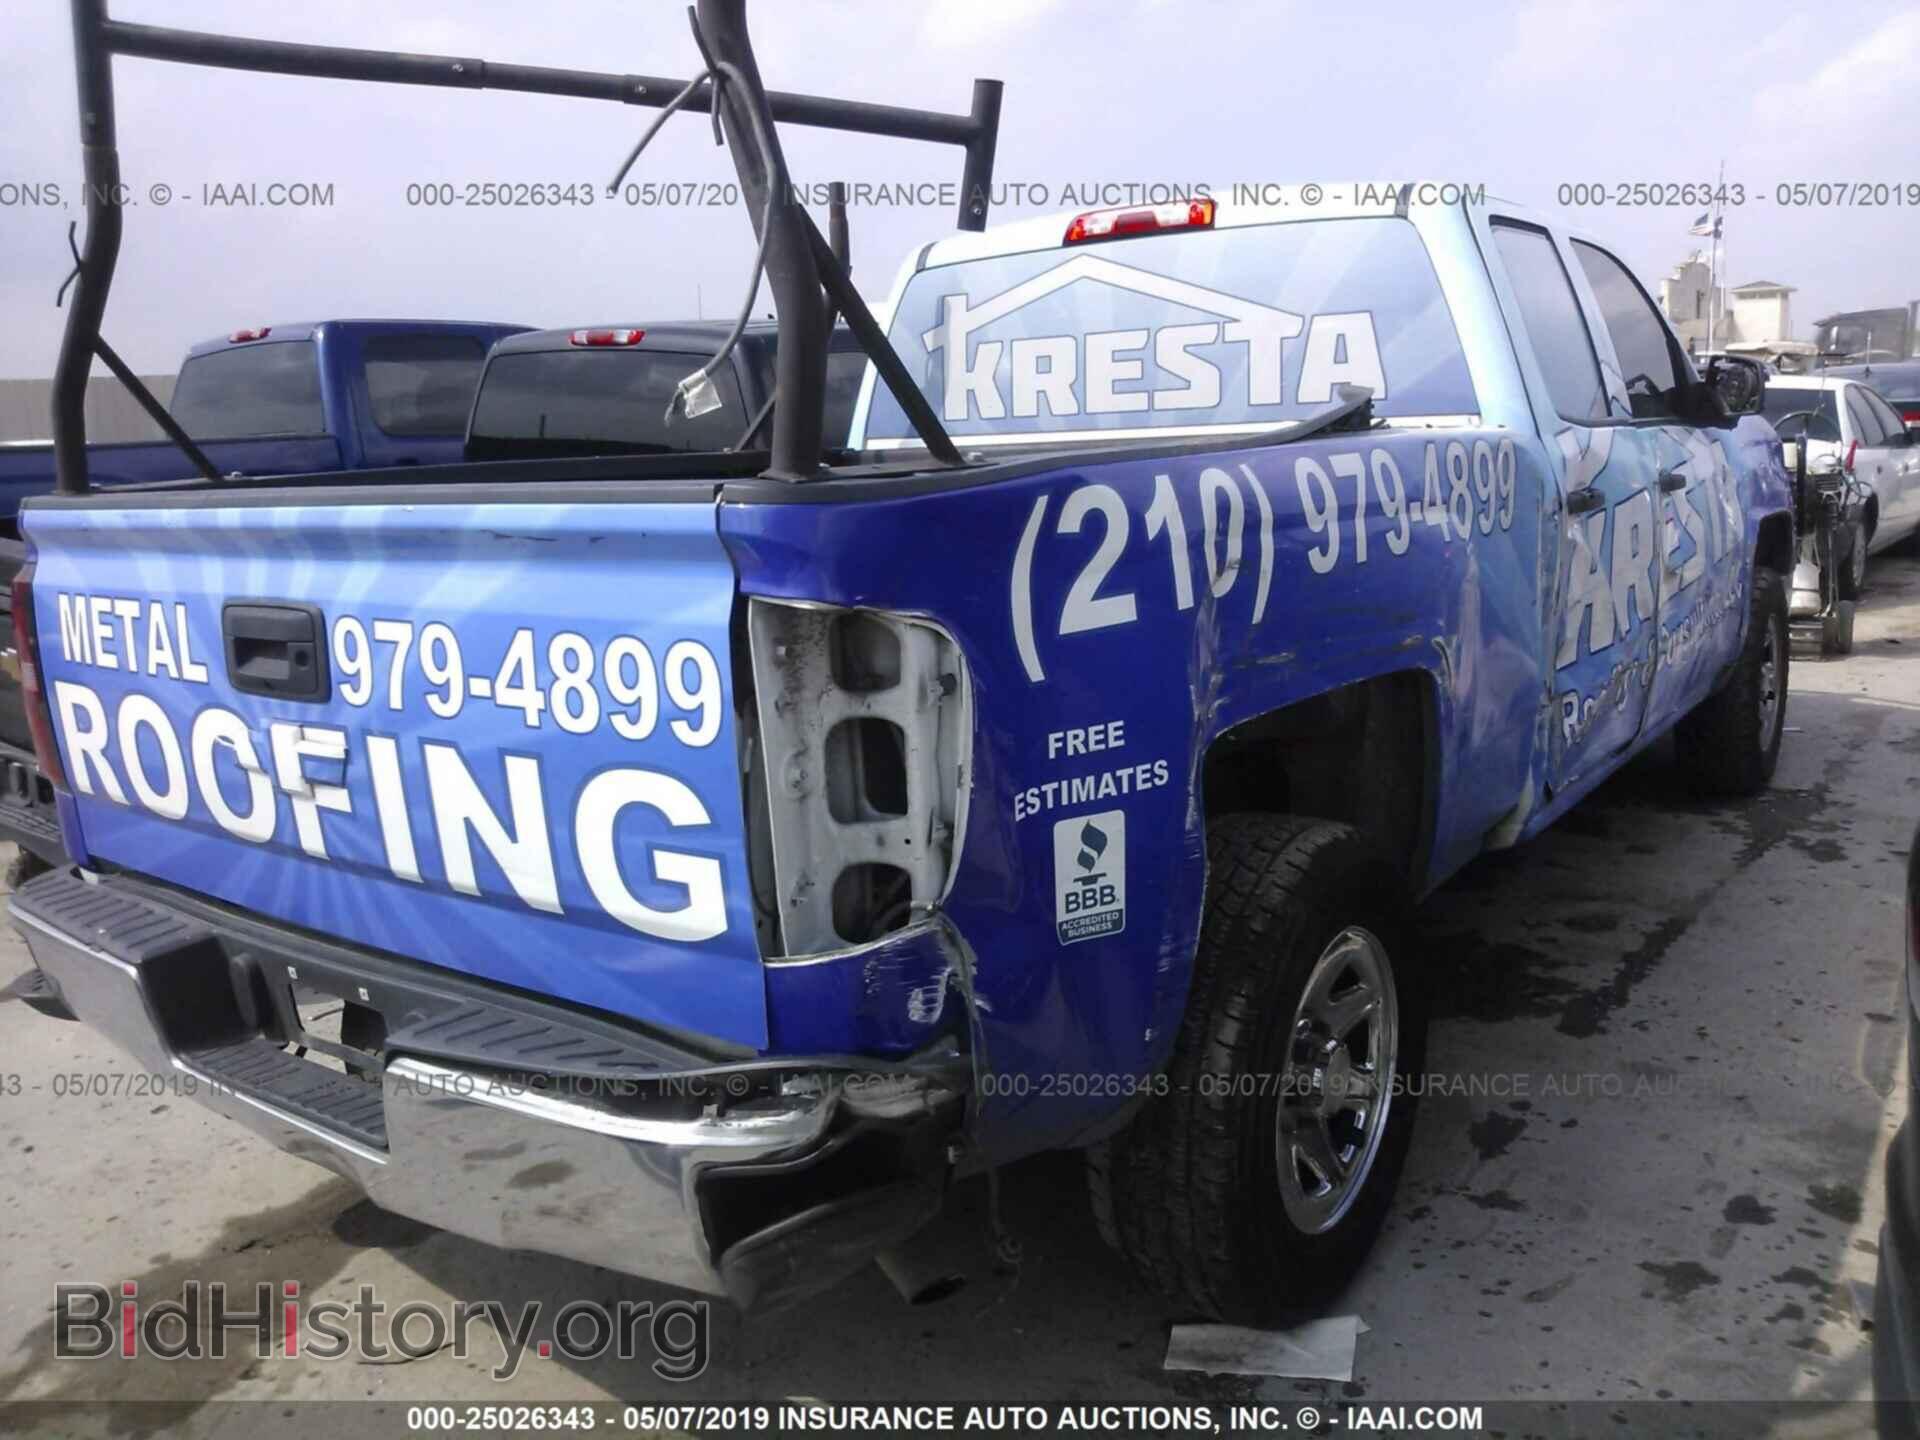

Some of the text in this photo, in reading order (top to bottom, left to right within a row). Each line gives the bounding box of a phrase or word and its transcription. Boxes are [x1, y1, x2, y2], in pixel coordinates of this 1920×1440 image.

[942, 293, 1388, 421] KRESTA
[1010, 439, 1517, 682] (210) 979-4899
[57, 593, 208, 684] METAL
[333, 616, 722, 748] 979-4899
[1048, 720, 1126, 760] FREE
[54, 681, 729, 942] ROOFING
[1014, 760, 1169, 822] ESTIMATES
[1061, 911, 1120, 931] ACCREDITED
[1065, 884, 1116, 914] BBB
[1067, 921, 1113, 938] BUSINESS
